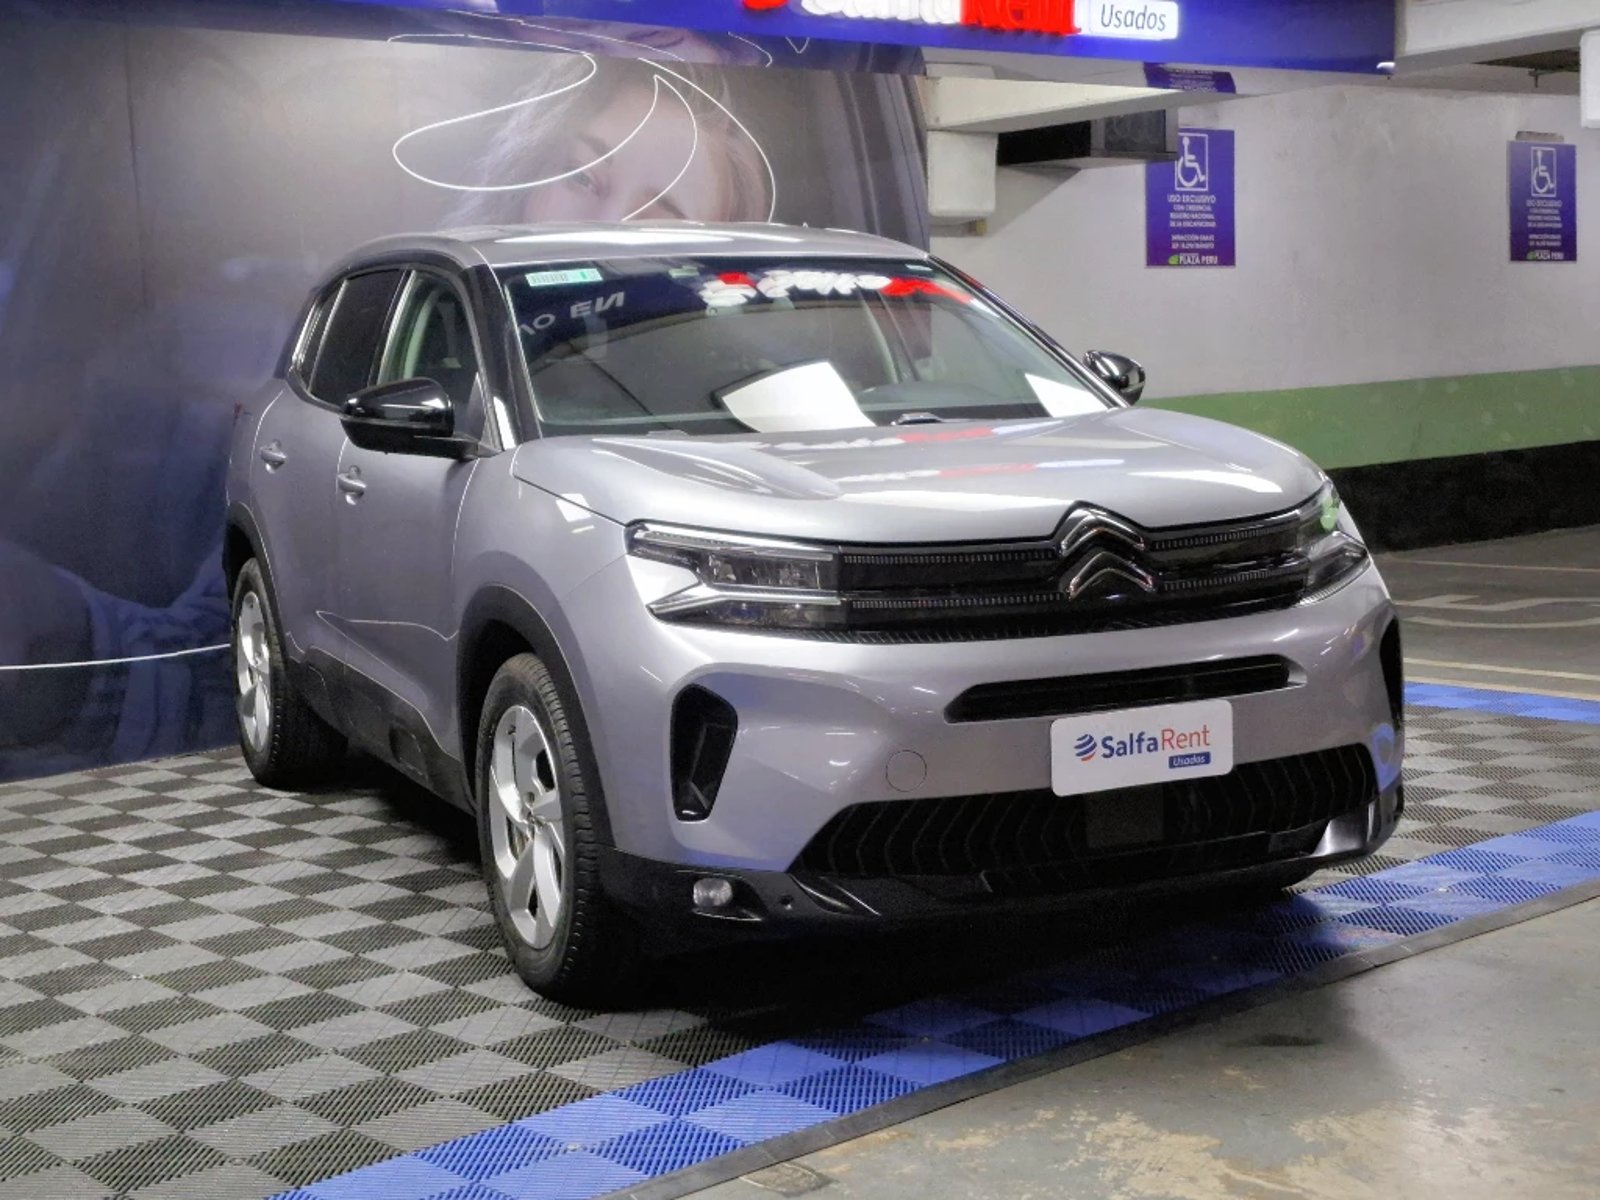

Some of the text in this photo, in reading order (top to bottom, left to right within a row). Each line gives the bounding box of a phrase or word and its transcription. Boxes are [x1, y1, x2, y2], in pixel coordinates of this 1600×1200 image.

[1101, 3, 1167, 32] Usados
[1179, 256, 1200, 265] PLAZA
[1172, 754, 1206, 767] Usados
